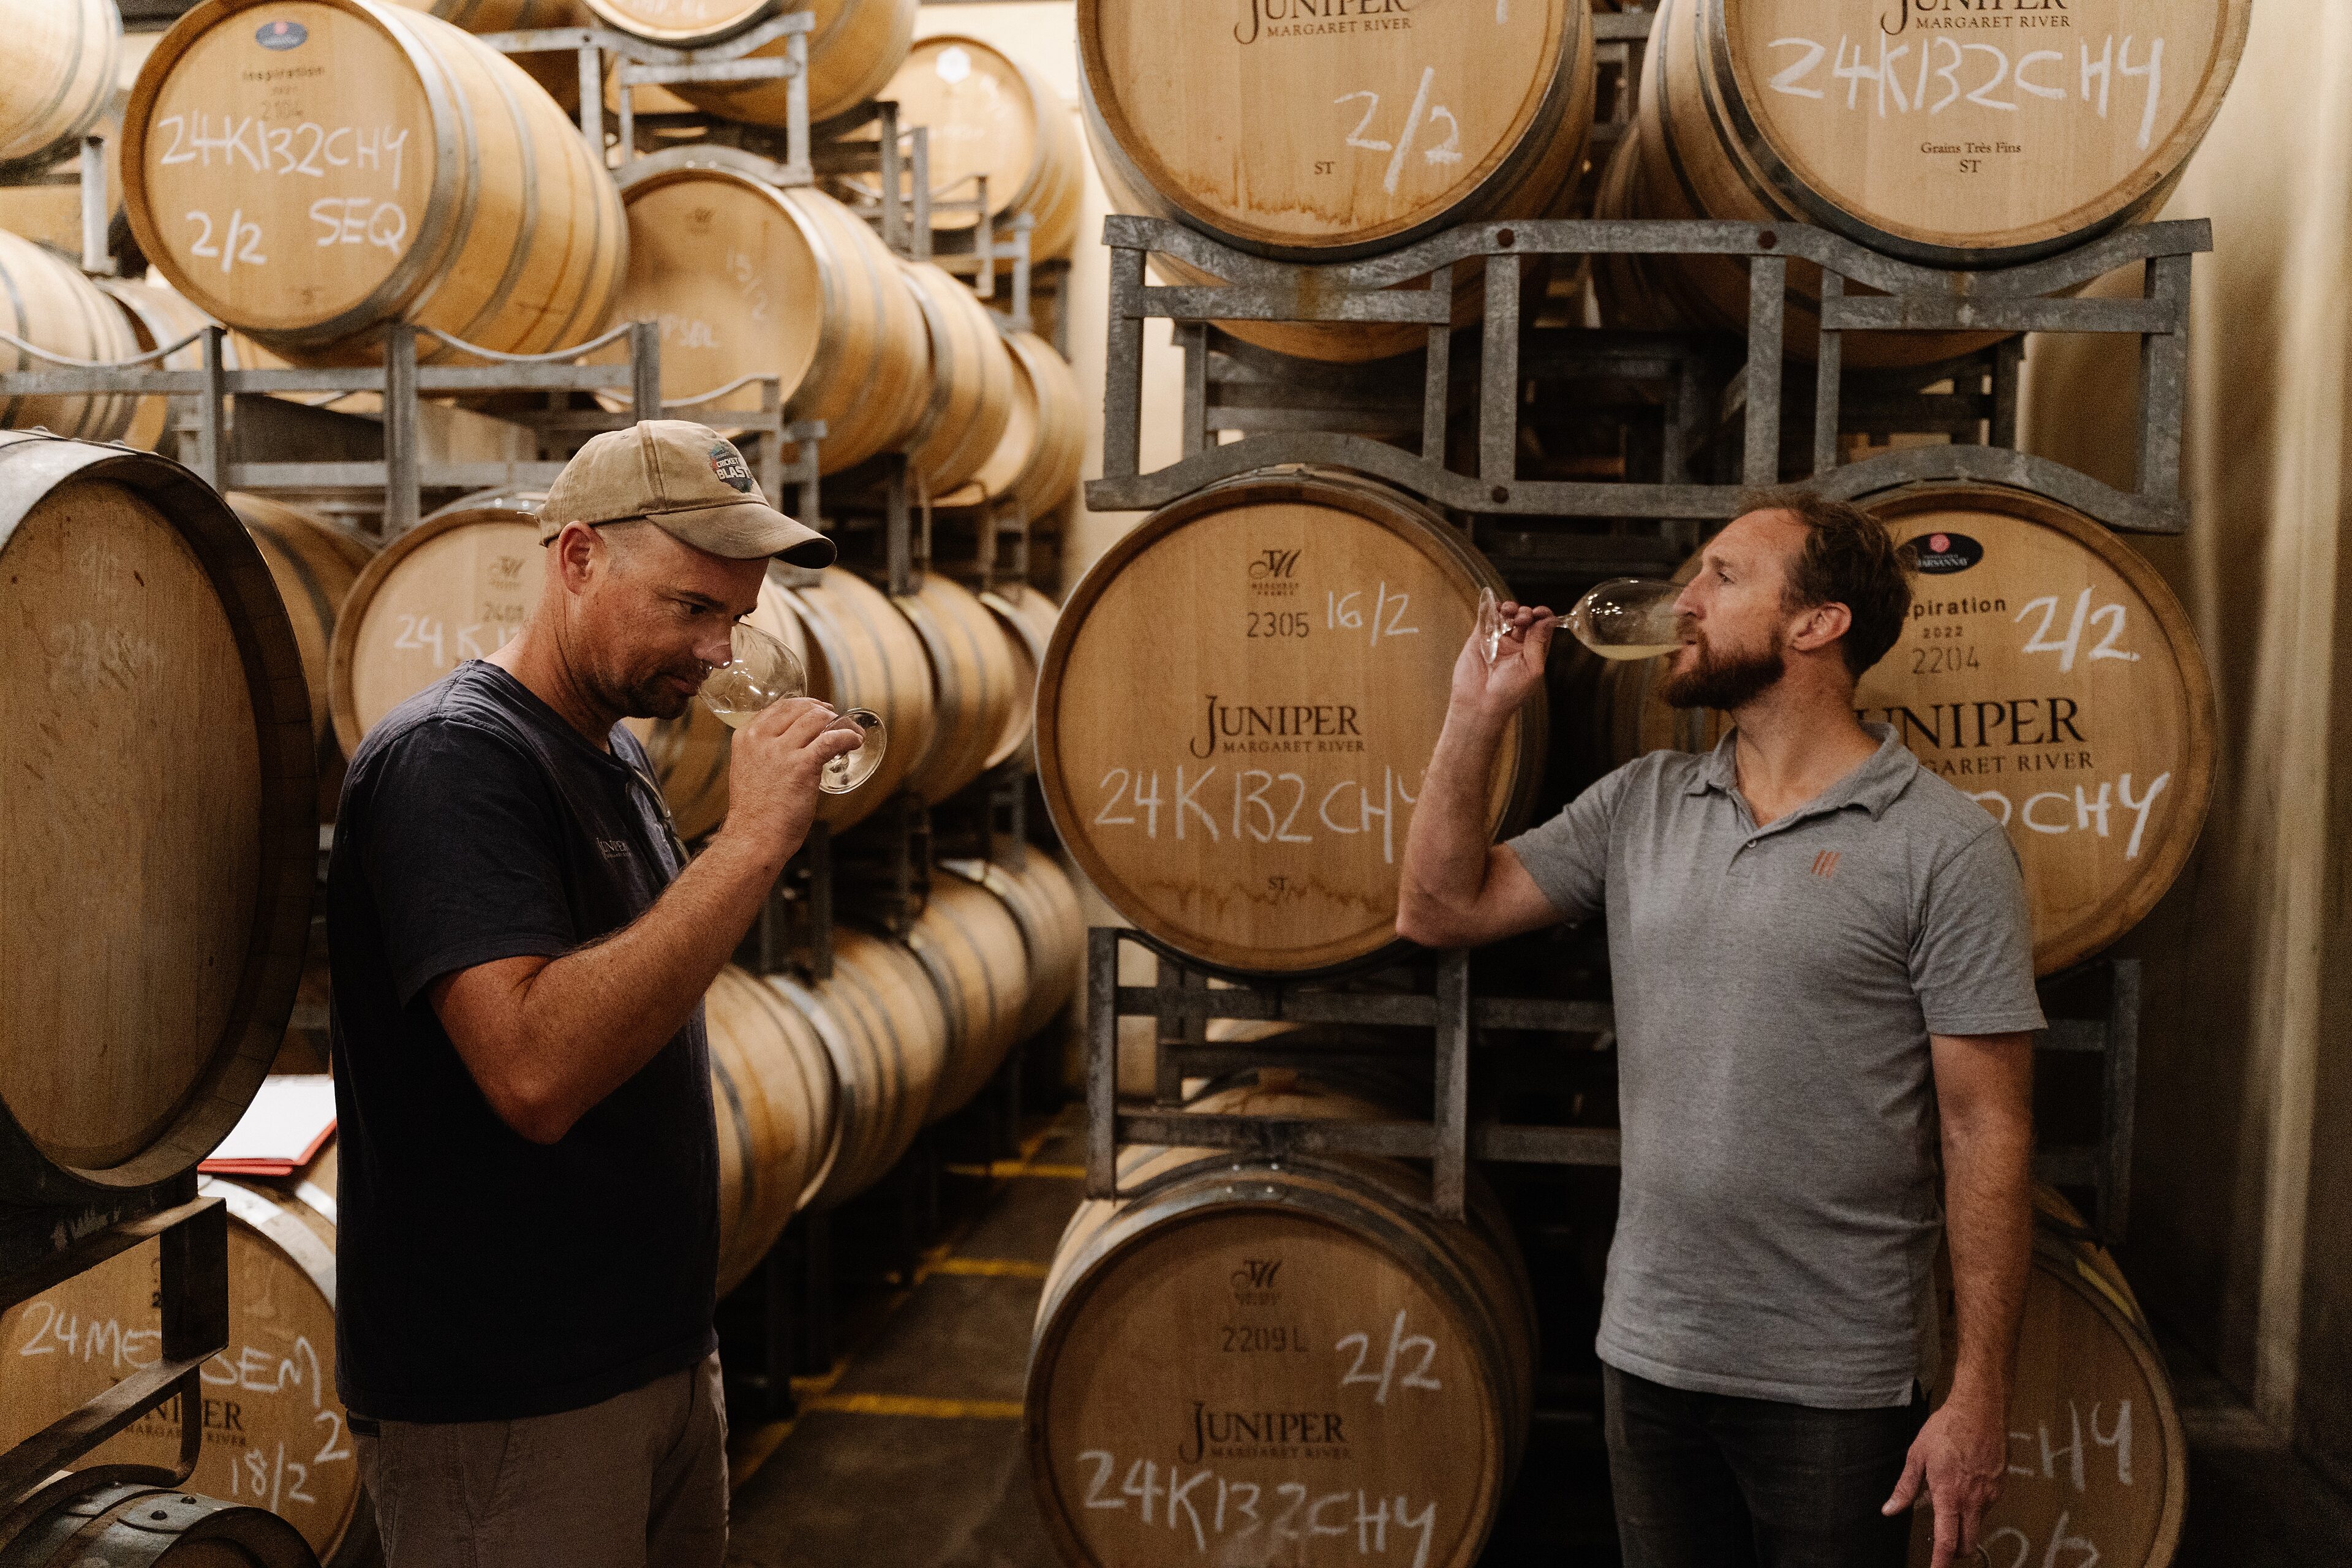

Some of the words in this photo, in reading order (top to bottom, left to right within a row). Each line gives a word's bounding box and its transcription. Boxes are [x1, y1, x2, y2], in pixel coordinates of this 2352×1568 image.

[1267, 21, 1357, 37] MARGARET
[1364, 18, 1412, 32] RIVER
[1915, 16, 2013, 29] MARGARET
[2019, 16, 2071, 28] RIVER
[1333, 67, 1463, 195] 2/2
[1921, 141, 1961, 154] Grains
[1965, 141, 1992, 154] Très
[1996, 141, 2022, 154] Fins
[1314, 160, 1336, 175] ST
[1959, 159, 1981, 173] ST
[309, 197, 408, 255] SEQ
[186, 209, 268, 273] 2/2
[716, 457, 739, 468] CRICKET
[716, 466, 751, 480] BLAST
[1327, 581, 1419, 647] 16/2
[1909, 597, 2007, 620] piration
[1247, 611, 1310, 638] 2305
[1923, 626, 1964, 638] 2022
[2014, 584, 2139, 673] 2/2
[1912, 646, 1980, 674] 2204
[1190, 694, 1362, 759] JUNIPER
[1853, 697, 2086, 751] NIPER
[1224, 740, 1312, 754] MARGARET
[1319, 740, 1365, 753] RIVER
[1921, 755, 2006, 776] GARET
[2017, 752, 2094, 772] RIVER
[1268, 877, 1286, 891] ST
[1336, 1310, 1442, 1405] 2/2
[1178, 1400, 1348, 1464] JUNIPER
